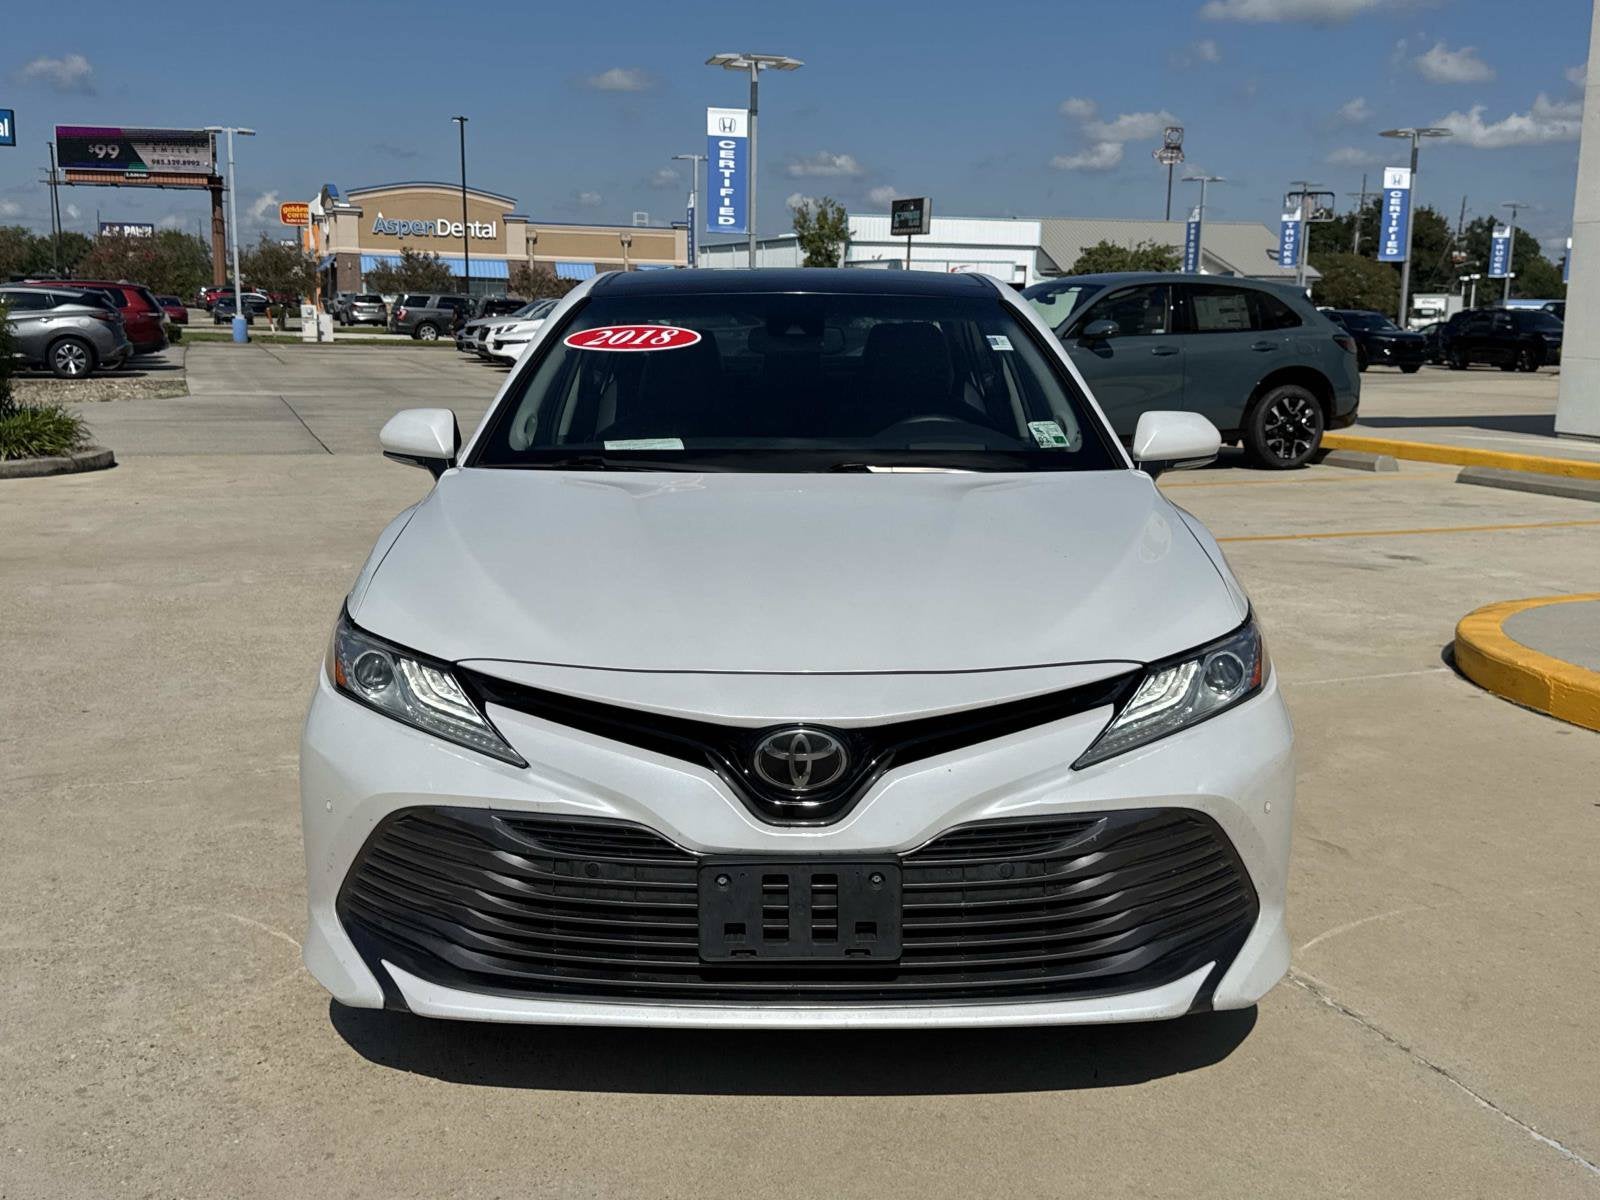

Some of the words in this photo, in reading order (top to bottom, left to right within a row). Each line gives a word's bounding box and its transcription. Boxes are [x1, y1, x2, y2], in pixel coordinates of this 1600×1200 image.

[88, 144, 120, 159] $99
[718, 140, 736, 225] CERTIFIED
[1283, 221, 1295, 264] TRUCKS
[1385, 190, 1403, 256] CERTIFIED
[582, 329, 680, 346] 2018
